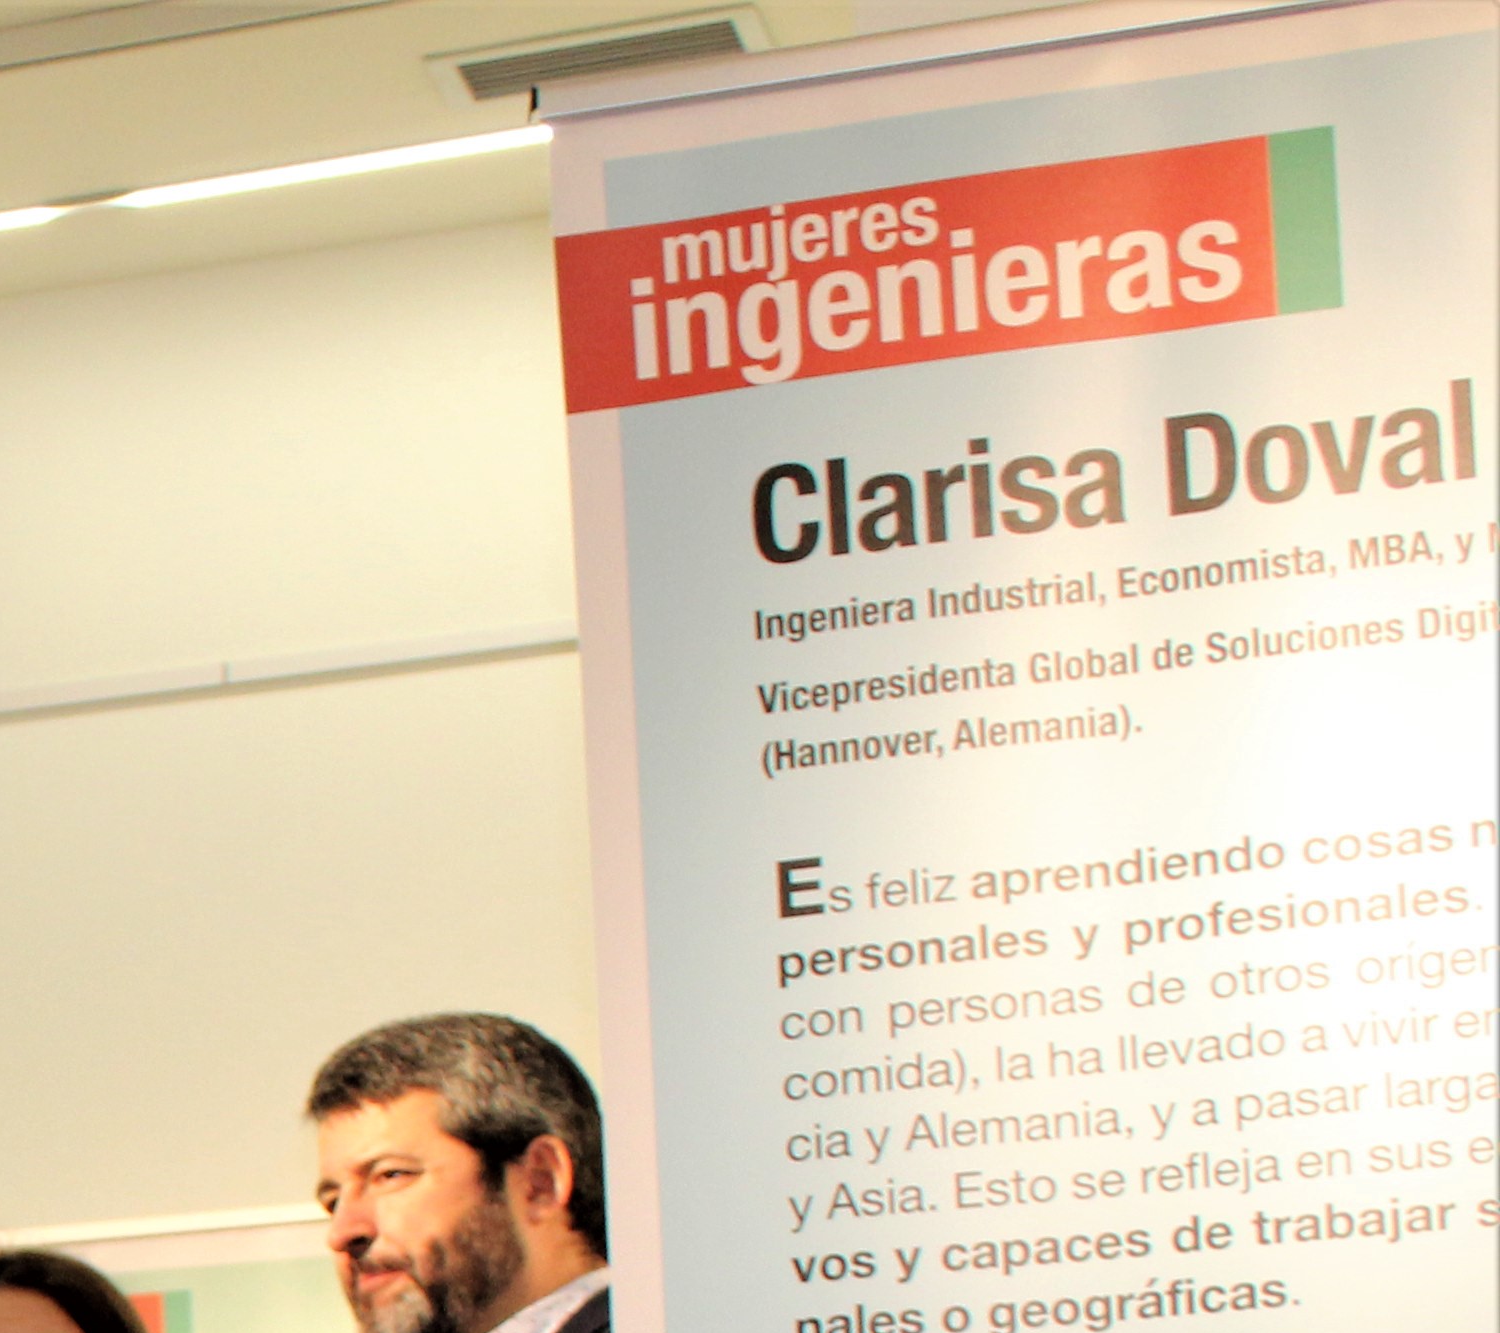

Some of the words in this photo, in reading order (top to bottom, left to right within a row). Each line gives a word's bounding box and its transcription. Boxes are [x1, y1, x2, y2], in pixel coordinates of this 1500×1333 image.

[662, 197, 939, 283] mujeres
[630, 219, 1242, 386] ingenieras
[753, 439, 1123, 564] Clarisa
[1164, 377, 1478, 518] Doval
[755, 598, 914, 643] Ingeniera
[928, 572, 1105, 618] Industrial,
[1118, 547, 1335, 598] Economista,
[1350, 531, 1443, 568] MBA,
[1456, 533, 1473, 563] y
[757, 660, 1014, 714] Vicepresidenta
[1029, 643, 1139, 683] Global
[1153, 639, 1193, 670] de
[1206, 619, 1403, 664] Soluciones
[762, 725, 945, 779] (Hannover,
[953, 705, 1142, 750] Alemania).
[778, 858, 850, 918] Es
[866, 868, 956, 908] feliz
[972, 836, 1284, 904] aprendiendo
[778, 926, 1047, 988] personales
[1073, 925, 1098, 960] y
[1124, 880, 1486, 955] profesionales.
[783, 1051, 979, 1101] comida),
[996, 1046, 1034, 1081] la
[1049, 1042, 1104, 1076] ha
[1119, 1023, 1285, 1071] llevado
[792, 1252, 875, 1283] vos
[896, 1248, 920, 1283] y
[942, 1230, 1151, 1275] capaces
[1172, 1216, 1232, 1253] de
[1252, 1199, 1455, 1245] trabajar
[943, 1306, 970, 1333] o
